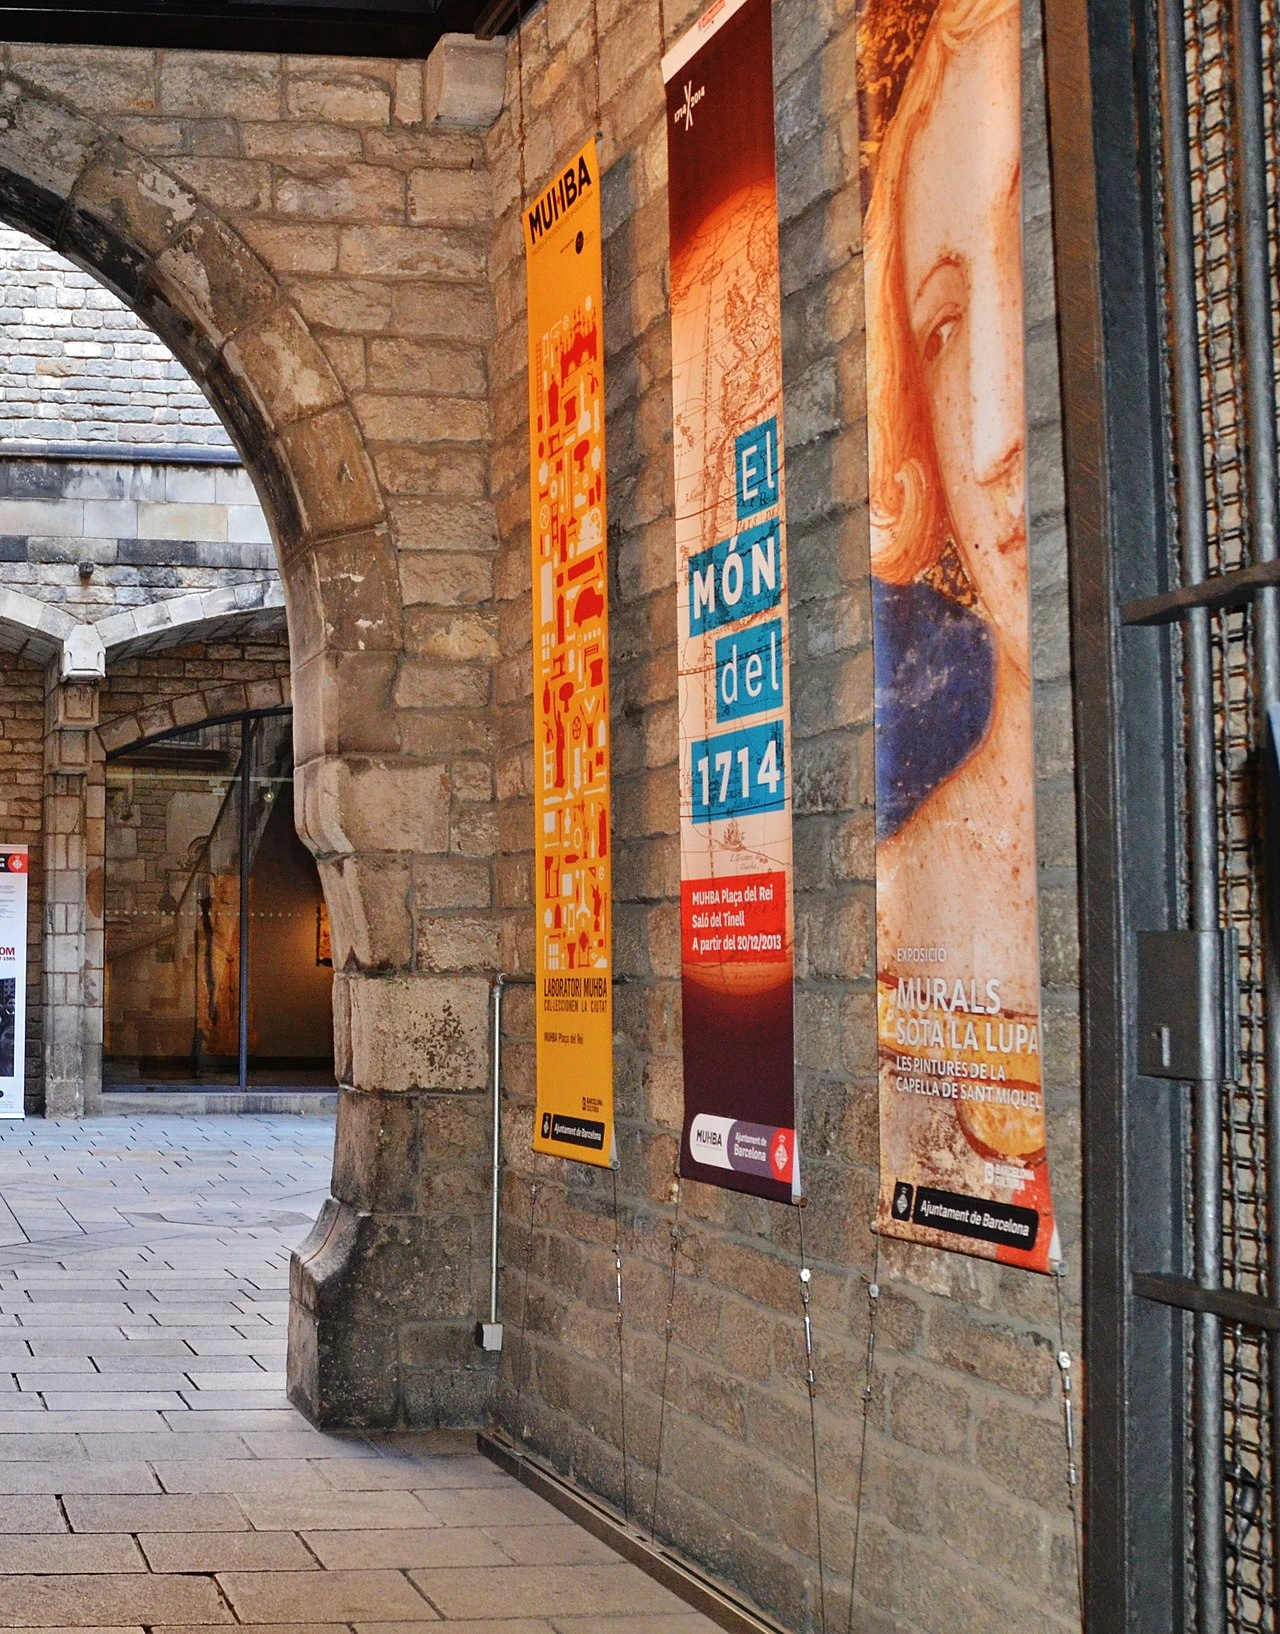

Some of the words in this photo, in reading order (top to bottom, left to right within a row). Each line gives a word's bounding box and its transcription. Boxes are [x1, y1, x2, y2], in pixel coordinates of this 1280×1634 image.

[690, 85, 706, 108] 2014
[528, 155, 592, 245] MUHBA
[741, 430, 775, 501] El
[693, 533, 776, 620] MÓN
[721, 631, 779, 705] del
[697, 740, 780, 806] 1714
[692, 890, 720, 905] MUHBA
[721, 888, 743, 907] Plaça
[744, 886, 757, 902] del
[759, 884, 774, 901] Rei
[691, 912, 709, 928] Saló
[710, 912, 722, 928] del
[723, 910, 745, 927] Tinell
[692, 937, 698, 951] A
[700, 935, 722, 954] partir
[723, 935, 736, 951] del
[737, 933, 782, 952] 20/12/2013
[897, 945, 947, 962] EXPOSICIÓ
[543, 978, 581, 997] LABORATORI
[583, 977, 607, 998] MUHBA
[896, 977, 1001, 1015] MURALS
[581, 1000, 587, 1013] LA
[591, 1000, 607, 1013] CIUTAT
[544, 1032, 557, 1042] MUHBA
[895, 1018, 945, 1049] SOTA
[950, 1020, 979, 1051] LA
[985, 1023, 1039, 1055] LUPA
[896, 1055, 912, 1072] LES
[913, 1058, 968, 1078] PINTURES
[969, 1063, 987, 1079] DE
[990, 1064, 1006, 1081] LA
[896, 1076, 940, 1097] CAPELLA
[941, 1081, 959, 1099] DE
[960, 1083, 994, 1101] SANT
[995, 1087, 1042, 1110] MIQUEL
[554, 1122, 576, 1136] Ajuntament
[581, 1127, 601, 1141] Barcelona
[696, 1130, 722, 1147] MUHBA
[735, 1132, 759, 1145] Ajuntament
[760, 1136, 767, 1146] de
[734, 1143, 767, 1162] Barcelona
[995, 1163, 1036, 1181] BARCELONA
[920, 1199, 969, 1224] Ajuntament
[969, 1210, 981, 1225] de
[982, 1214, 1030, 1237] Barcelona
